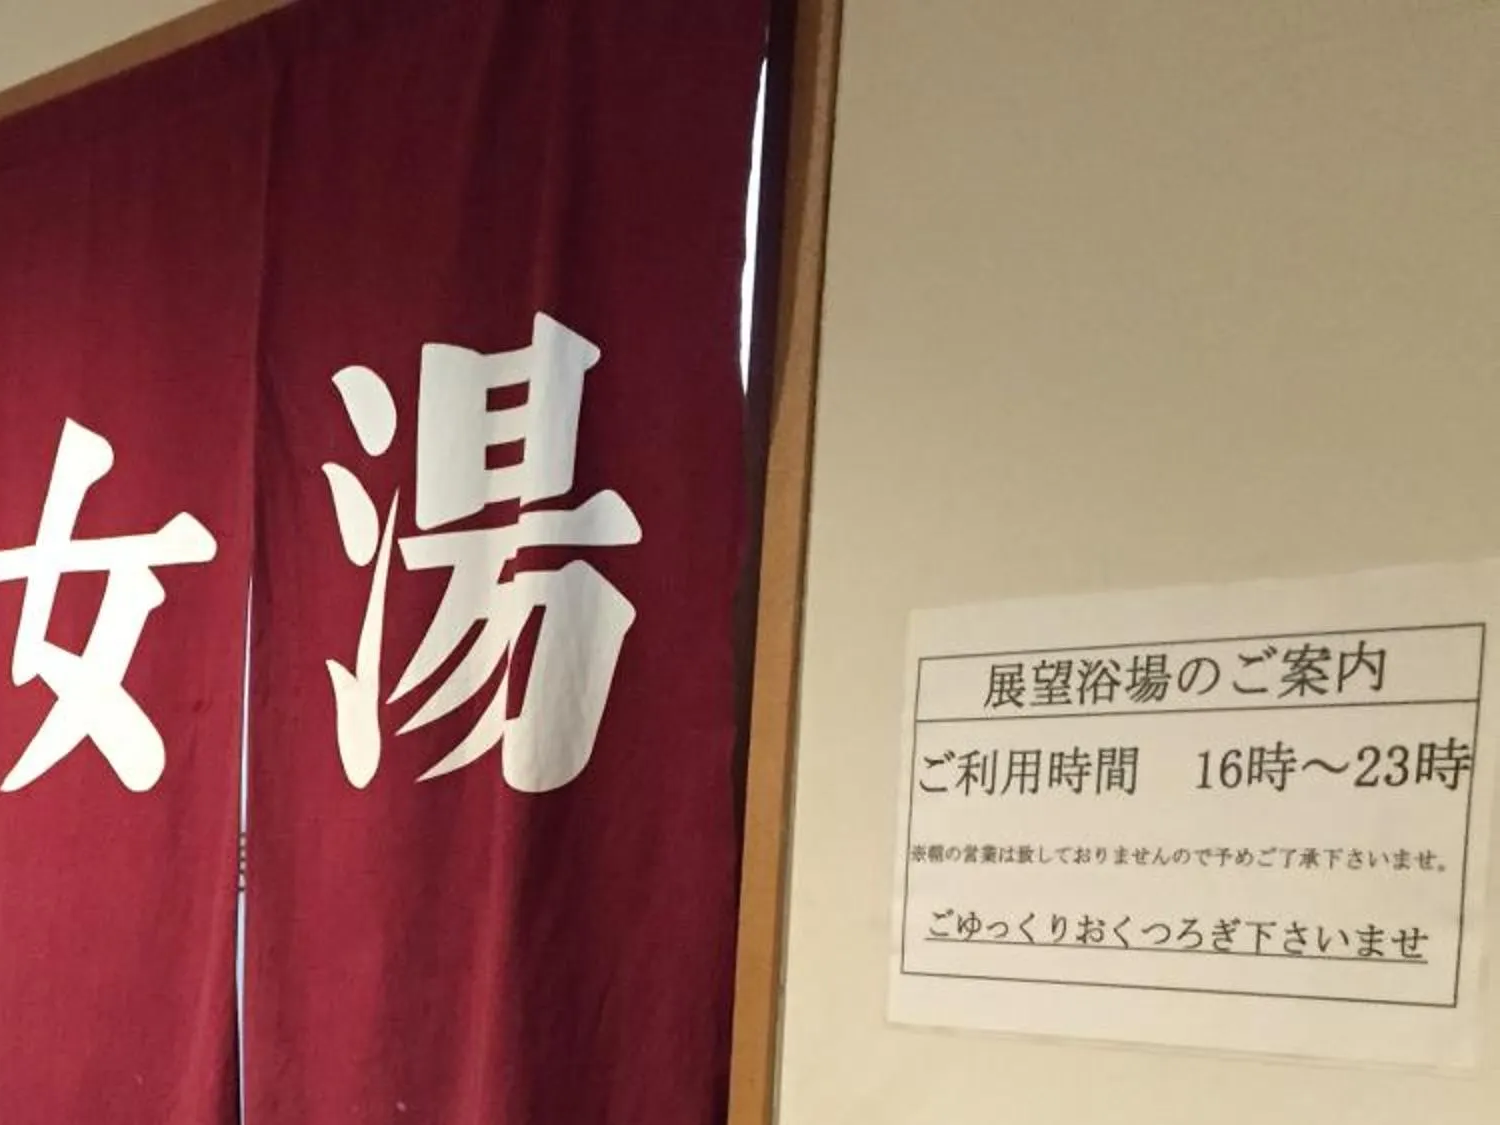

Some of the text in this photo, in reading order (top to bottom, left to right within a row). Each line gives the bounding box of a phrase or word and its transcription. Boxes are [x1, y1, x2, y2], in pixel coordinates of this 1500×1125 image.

[983, 640, 1387, 709] 展望浴場のご案内
[919, 746, 1140, 797] ご利用時間
[928, 908, 1430, 961] ごゆっくりおくつろぎ下さいませ
